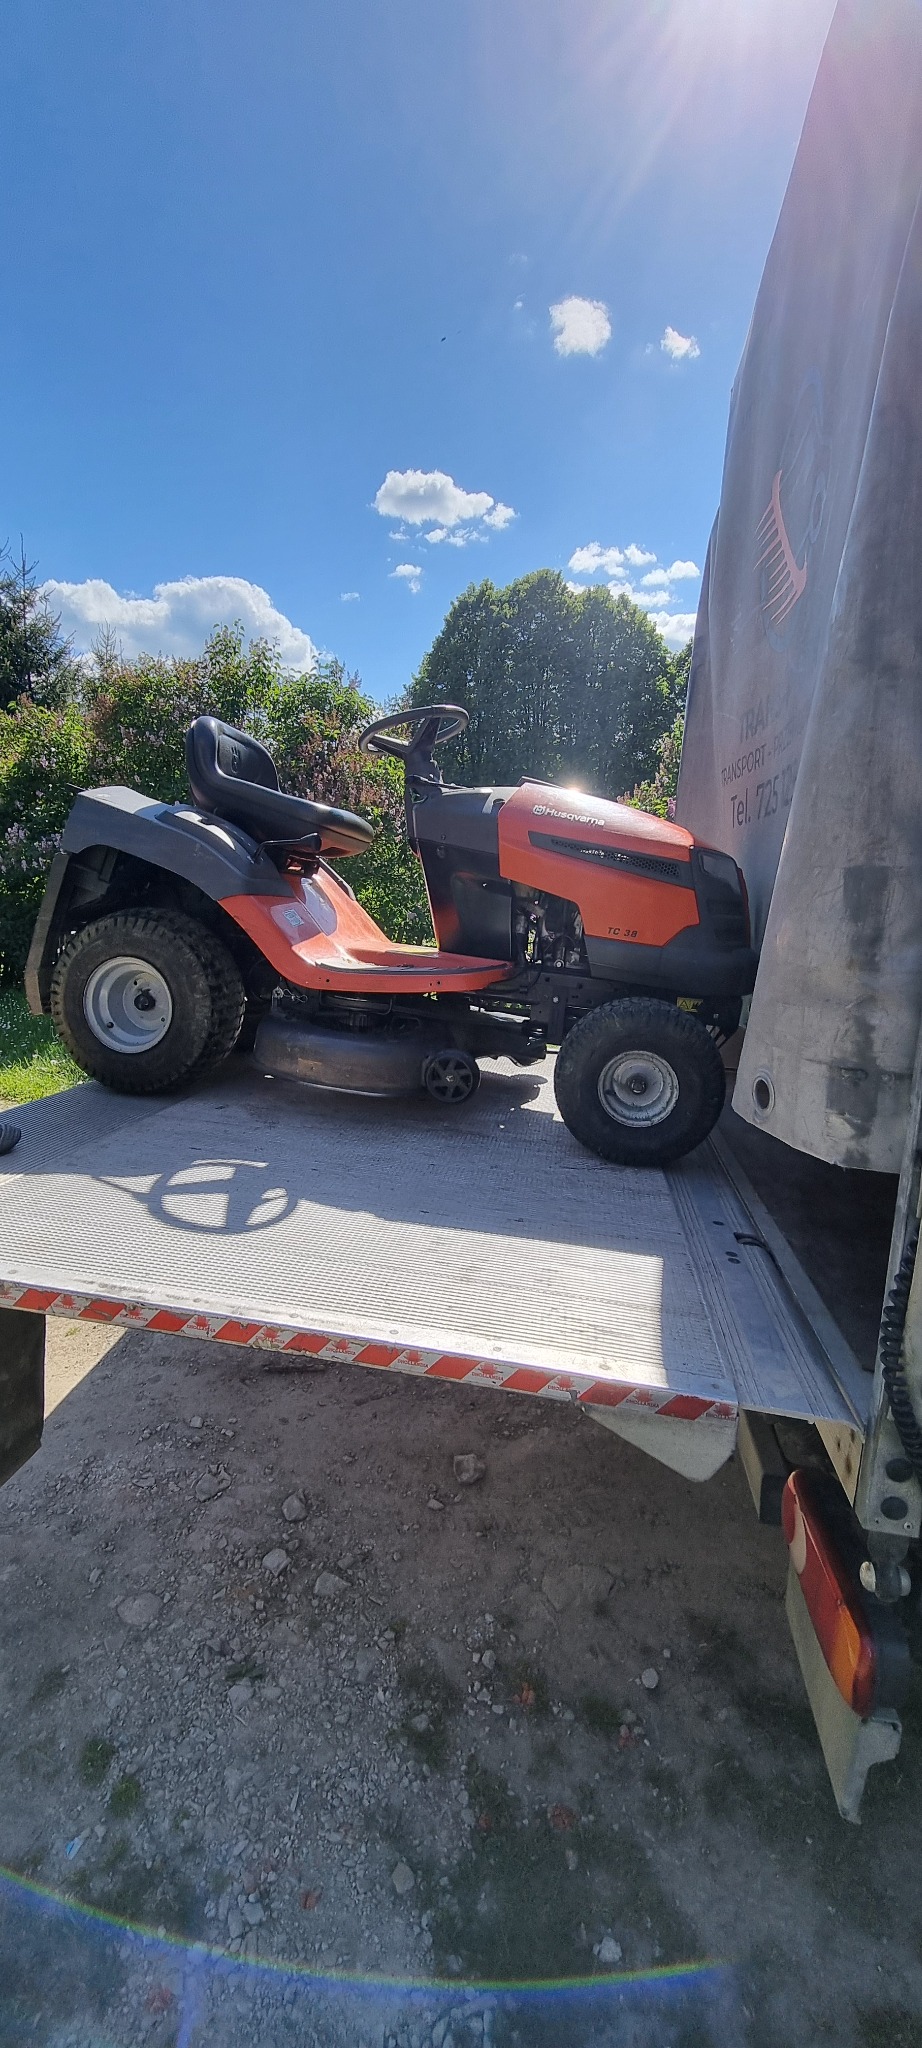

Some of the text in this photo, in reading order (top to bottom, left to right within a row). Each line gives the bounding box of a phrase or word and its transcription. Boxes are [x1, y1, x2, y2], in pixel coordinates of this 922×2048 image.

[720, 743, 767, 787] TRANSPORT
[545, 807, 605, 826] Husqvarna
[730, 788, 751, 829] Tel.
[755, 774, 779, 820] 725
[607, 927, 638, 938] TC 38
